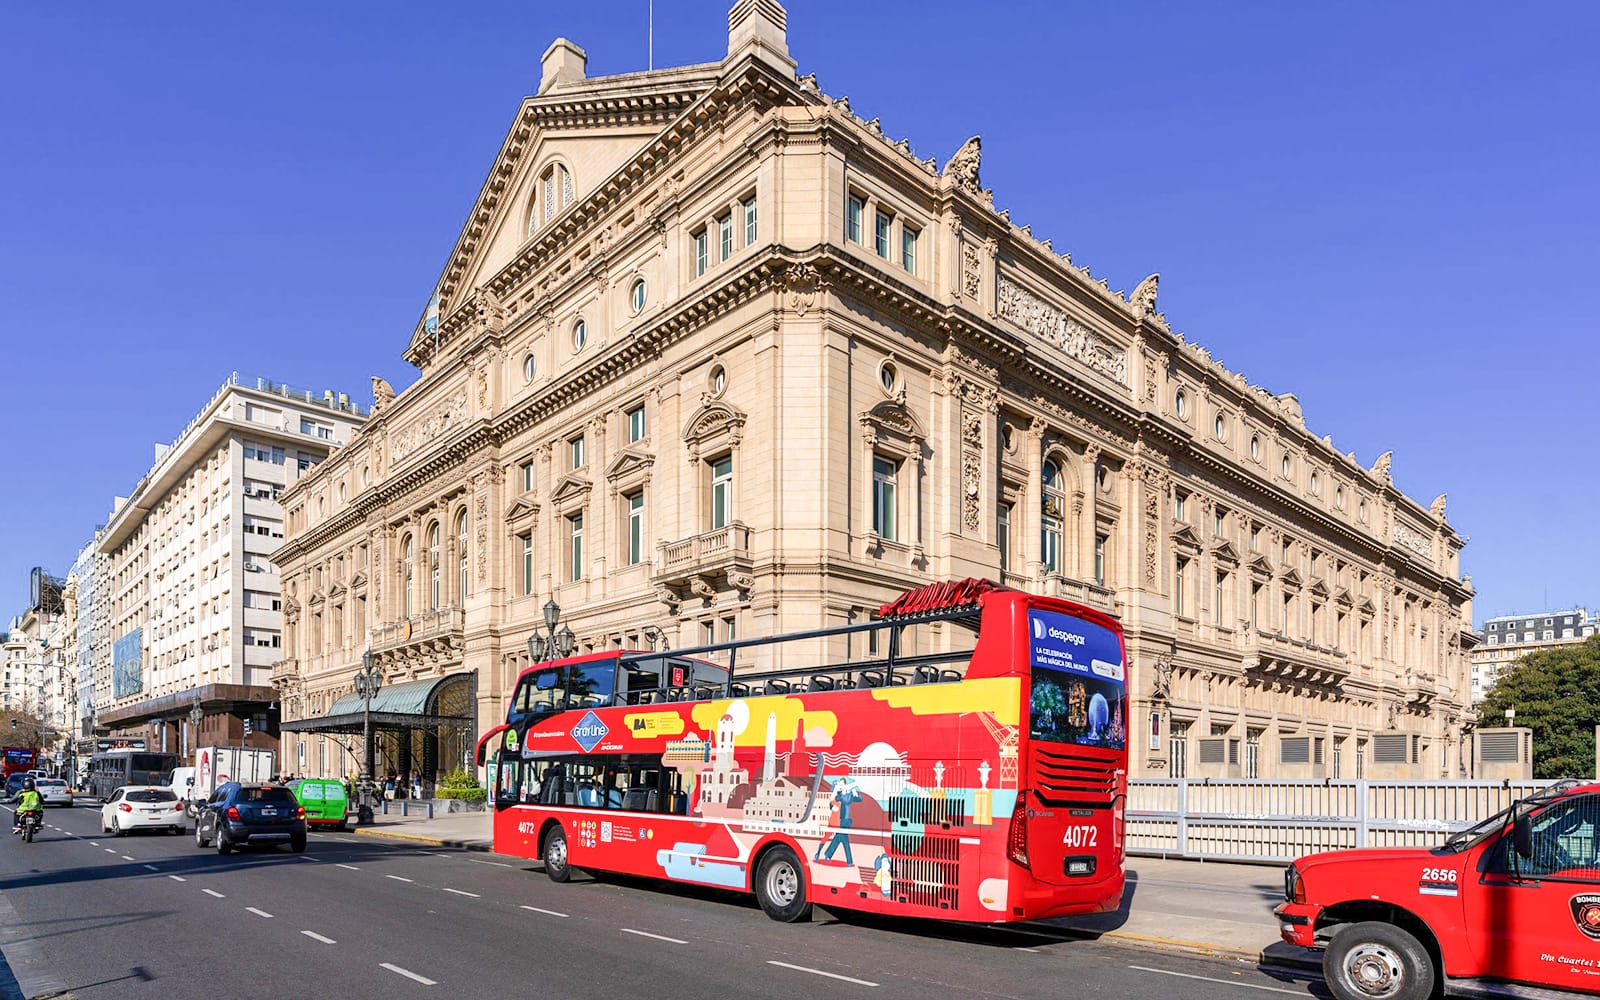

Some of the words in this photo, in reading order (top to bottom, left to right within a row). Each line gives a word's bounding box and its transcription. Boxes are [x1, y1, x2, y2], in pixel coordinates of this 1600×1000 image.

[1048, 626, 1085, 645] despegar
[1035, 646, 1043, 654] LA
[1073, 663, 1089, 672] MUNDO
[633, 718, 646, 730] BA
[518, 821, 535, 834] 4072
[1063, 825, 1097, 848] 4072
[1421, 867, 1457, 882] 2656
[1557, 956, 1594, 967] Cuartel
